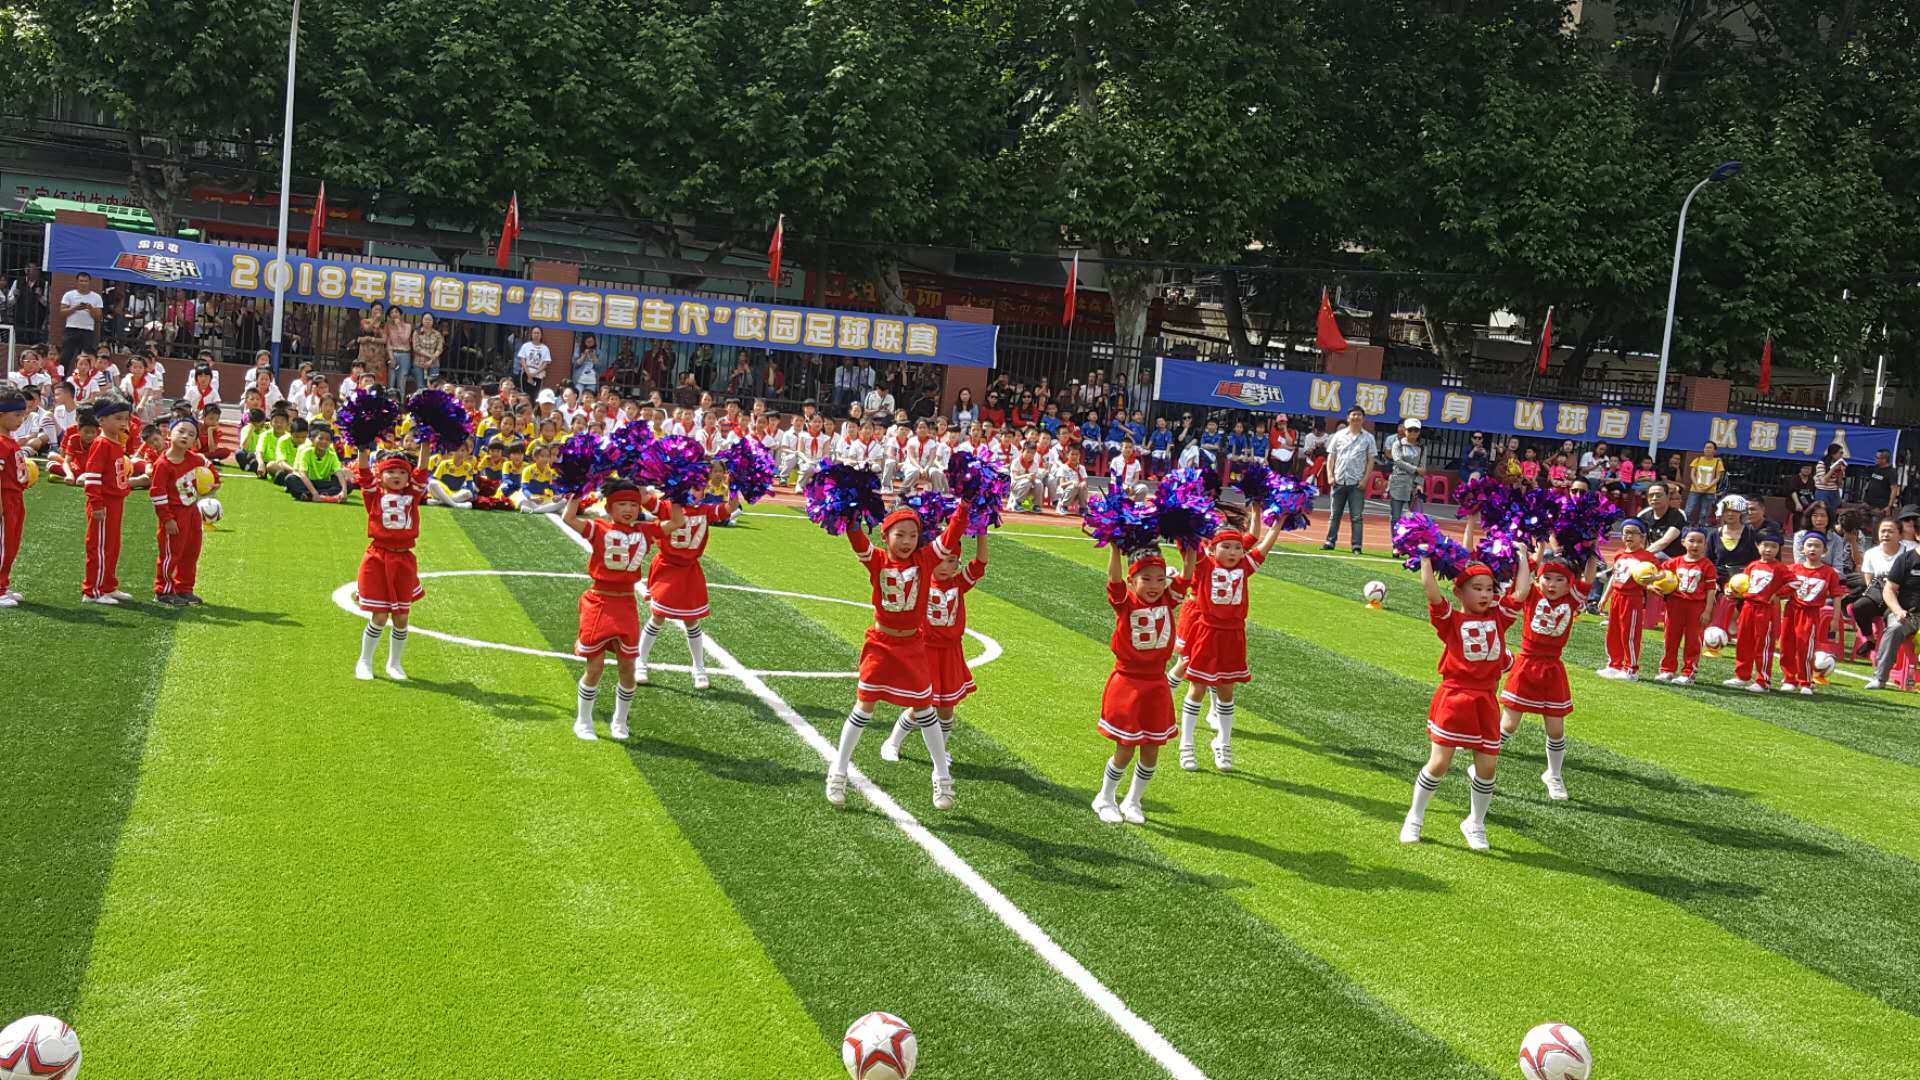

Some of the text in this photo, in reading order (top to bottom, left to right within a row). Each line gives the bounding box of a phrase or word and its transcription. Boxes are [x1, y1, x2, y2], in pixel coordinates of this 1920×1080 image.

[1309, 378, 1472, 425] 以球健身
[1514, 400, 1671, 442] 以球启智
[604, 531, 647, 571] 87
[880, 566, 919, 612] 87
[1211, 568, 1244, 604] 87
[1748, 569, 1773, 594] 7
[927, 587, 959, 626] 87
[1530, 598, 1571, 636] 87
[1130, 605, 1171, 650] 87
[1461, 620, 1500, 661] 87
